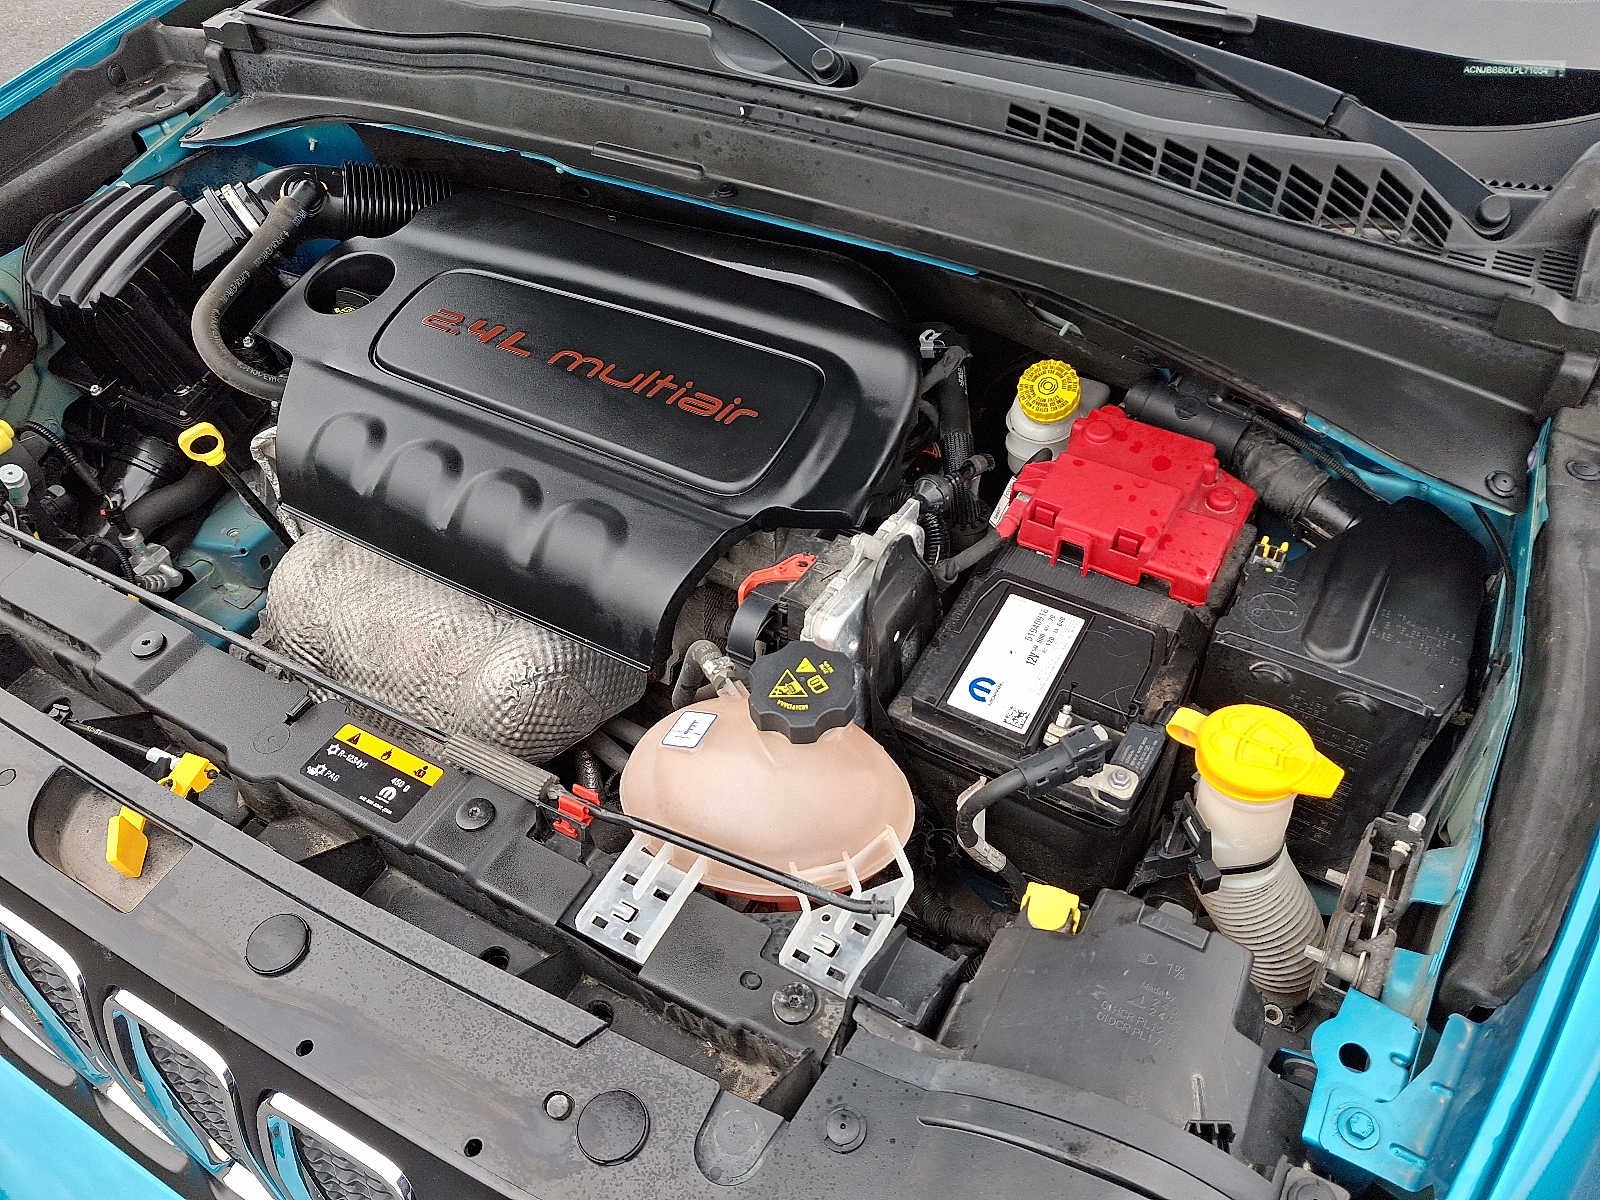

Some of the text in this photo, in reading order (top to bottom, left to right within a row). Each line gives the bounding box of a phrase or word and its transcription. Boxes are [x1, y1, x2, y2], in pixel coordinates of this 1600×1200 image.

[421, 308, 759, 425] 2.4L multiair
[323, 769, 341, 782] PAG
